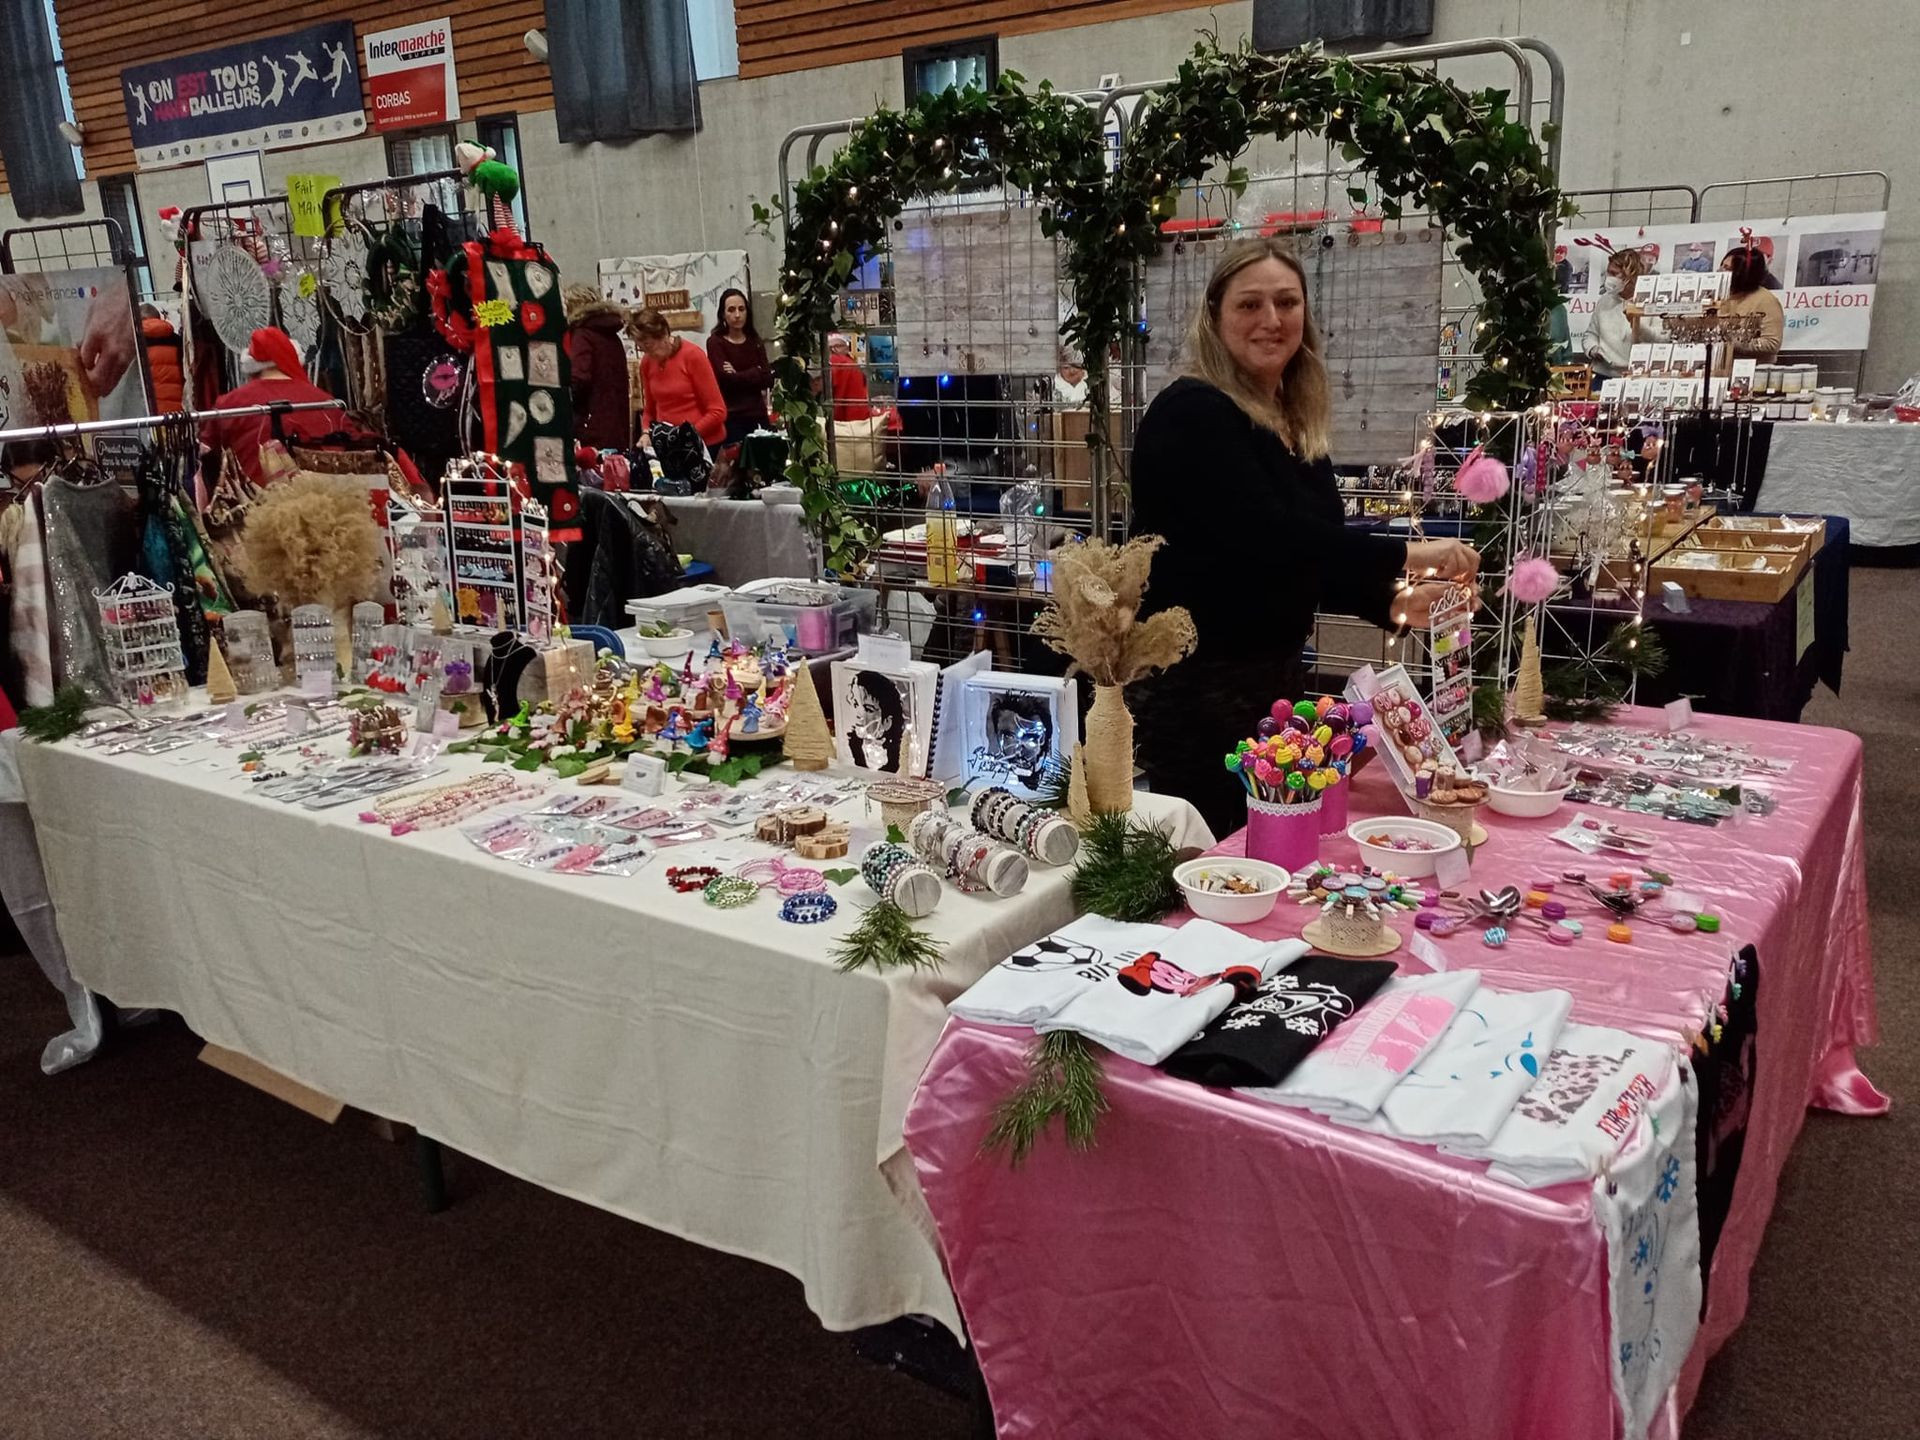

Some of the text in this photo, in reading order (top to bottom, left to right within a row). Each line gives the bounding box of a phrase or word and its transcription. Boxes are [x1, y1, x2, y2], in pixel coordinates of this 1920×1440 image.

[148, 60, 260, 104] ON EST TOUS
[376, 90, 411, 110] CORBAS
[45, 286, 78, 301] France
[1784, 290, 1870, 310] l'Action
